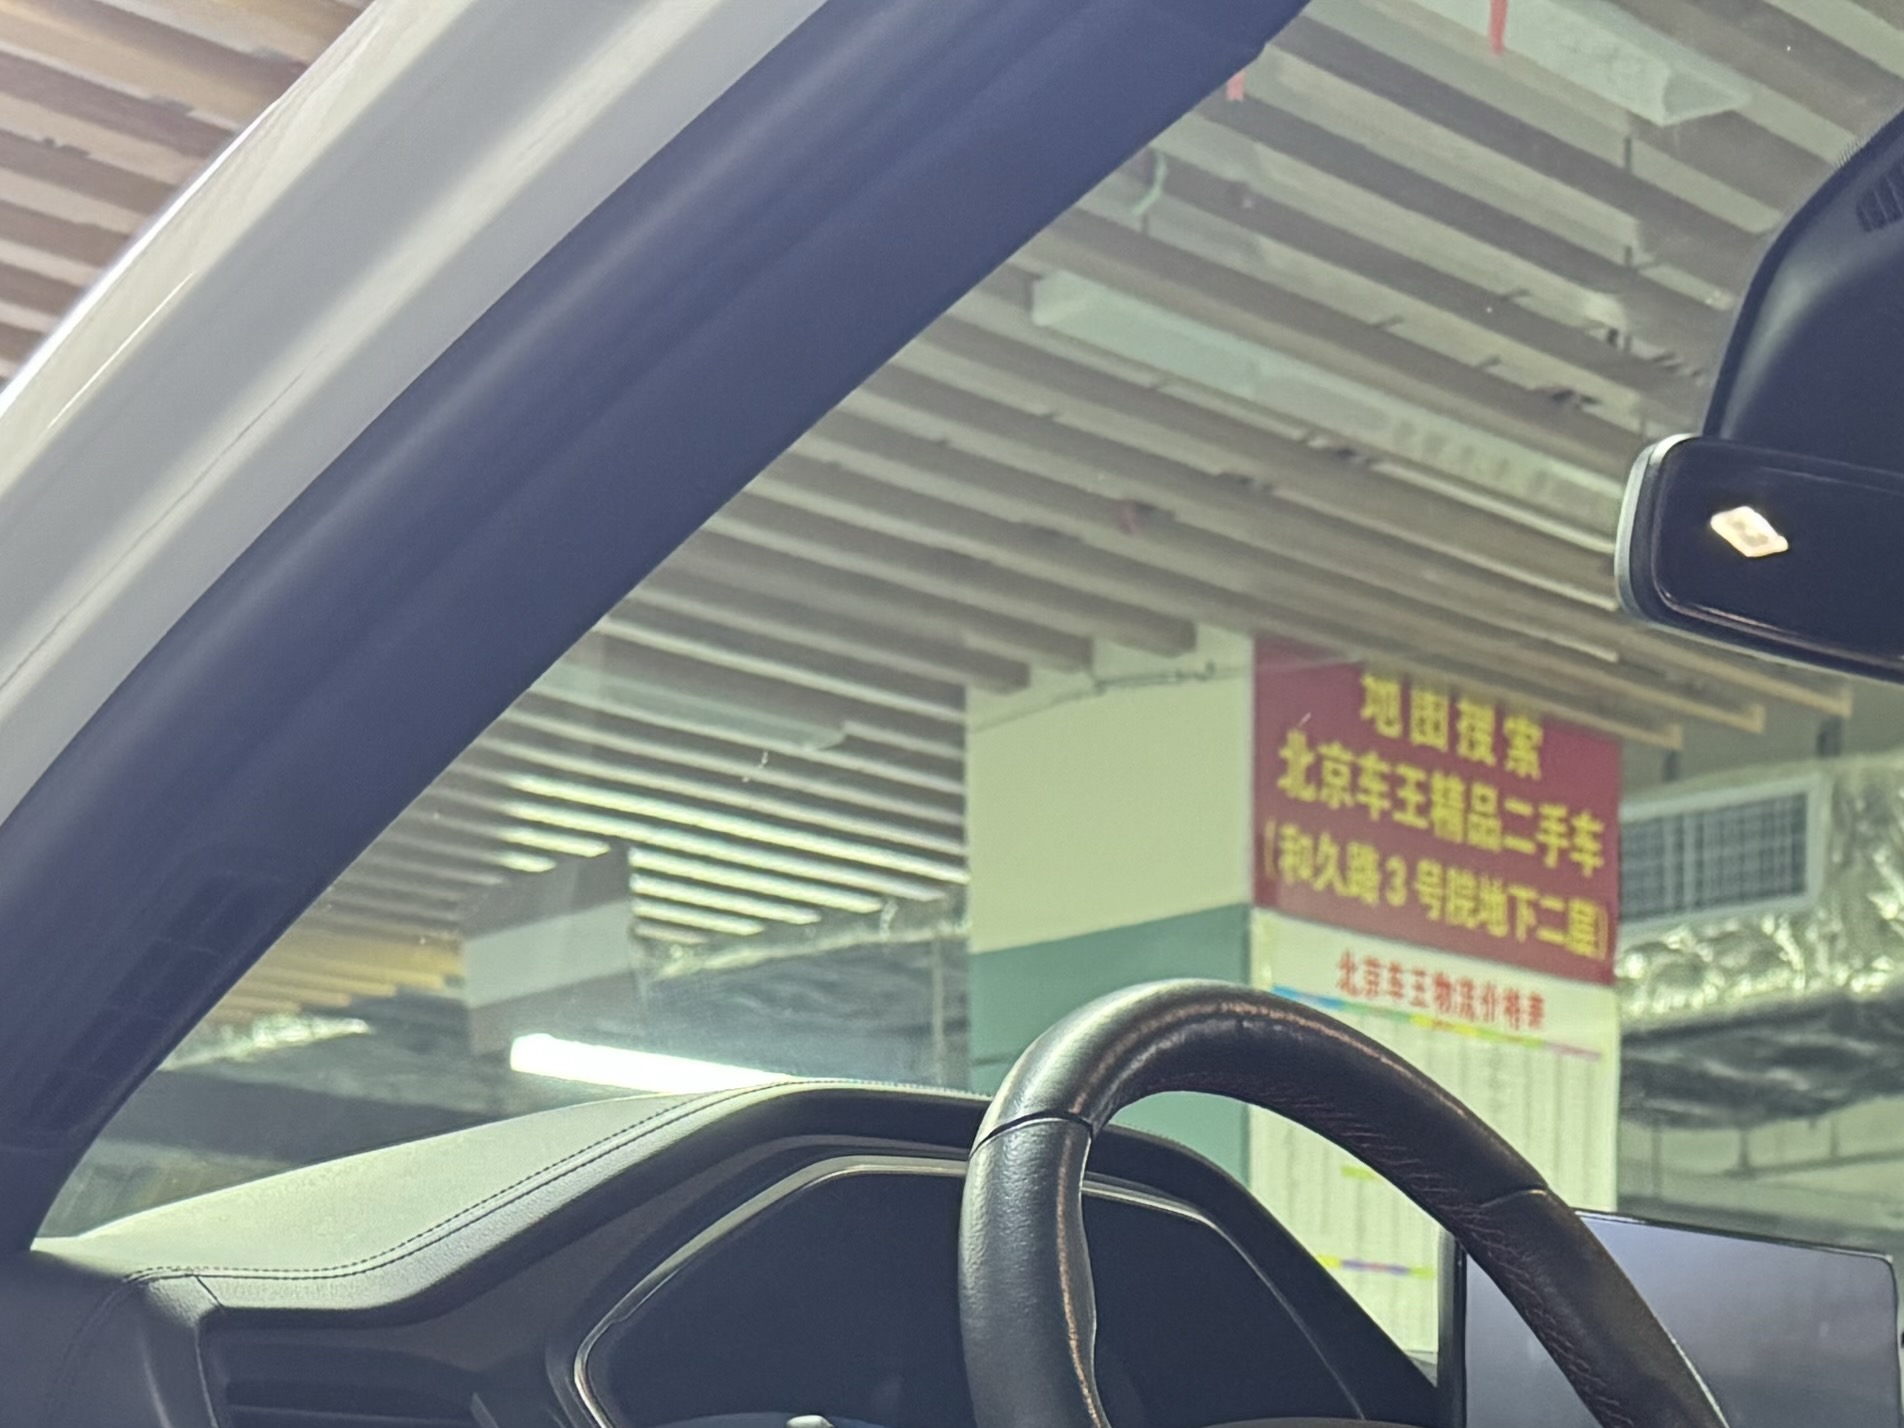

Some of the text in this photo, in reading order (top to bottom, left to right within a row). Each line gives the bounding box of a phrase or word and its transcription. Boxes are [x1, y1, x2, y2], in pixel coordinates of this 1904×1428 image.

[1360, 673, 1544, 780] 地图搜索
[1276, 728, 1605, 878] 北京车王精品二手车
